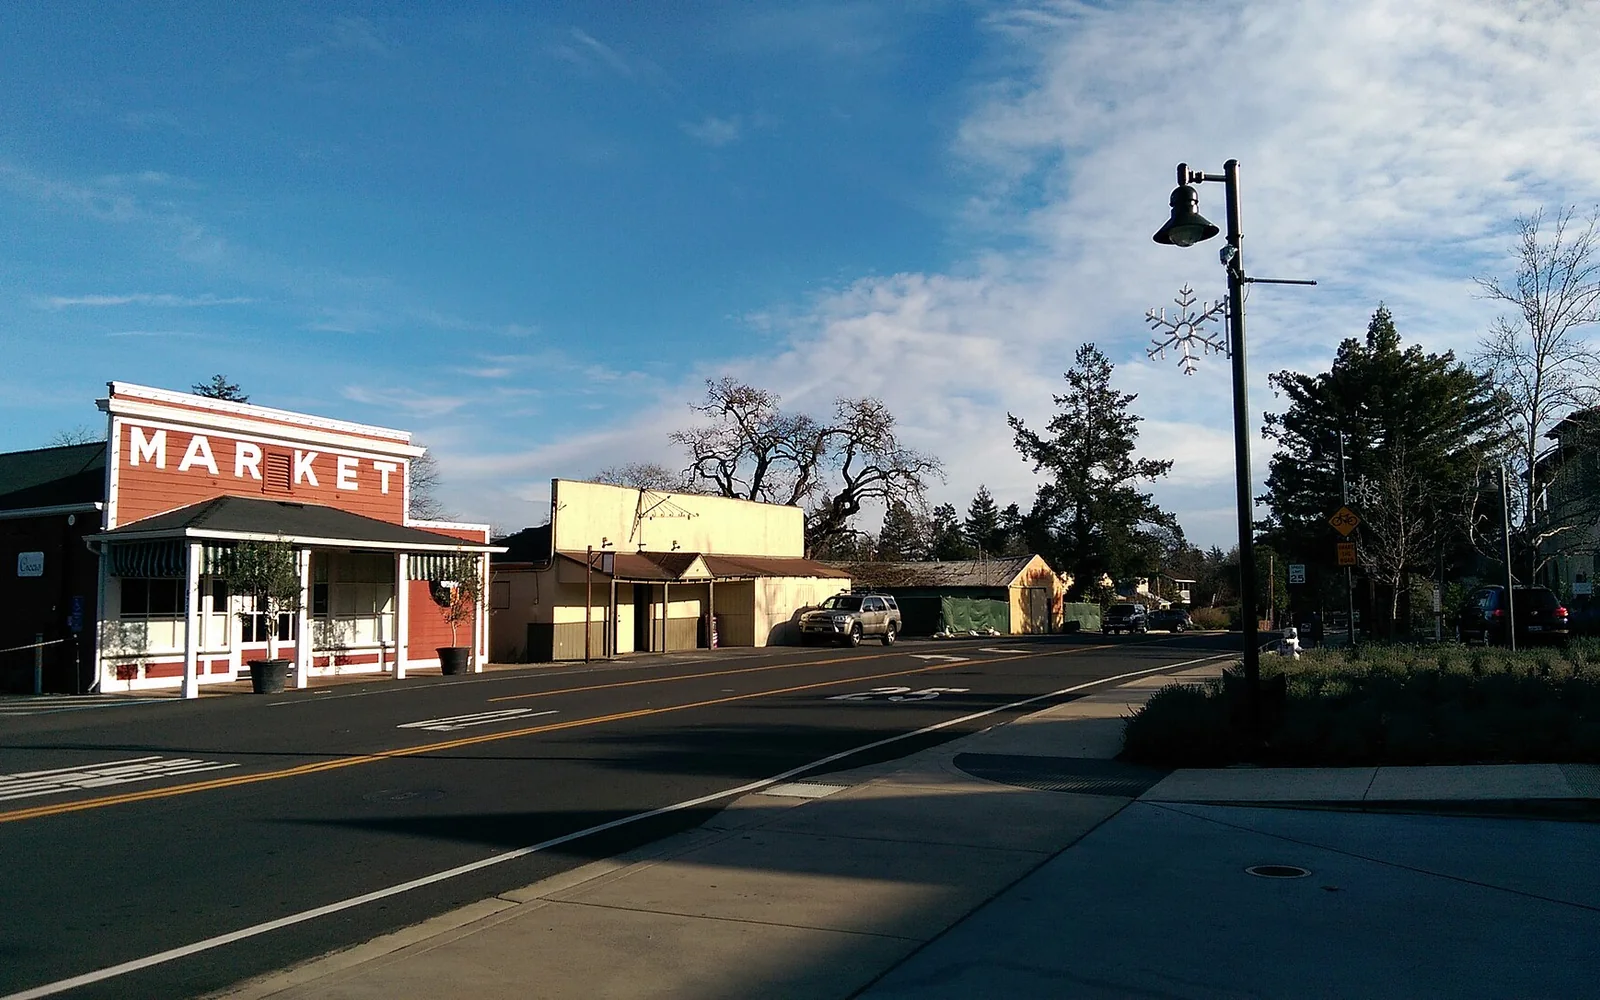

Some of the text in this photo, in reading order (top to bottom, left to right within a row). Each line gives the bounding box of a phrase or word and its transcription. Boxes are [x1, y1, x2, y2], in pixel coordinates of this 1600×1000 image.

[129, 426, 397, 494] MARKET
[1291, 574, 1304, 582] 25
[824, 686, 970, 701] 25
